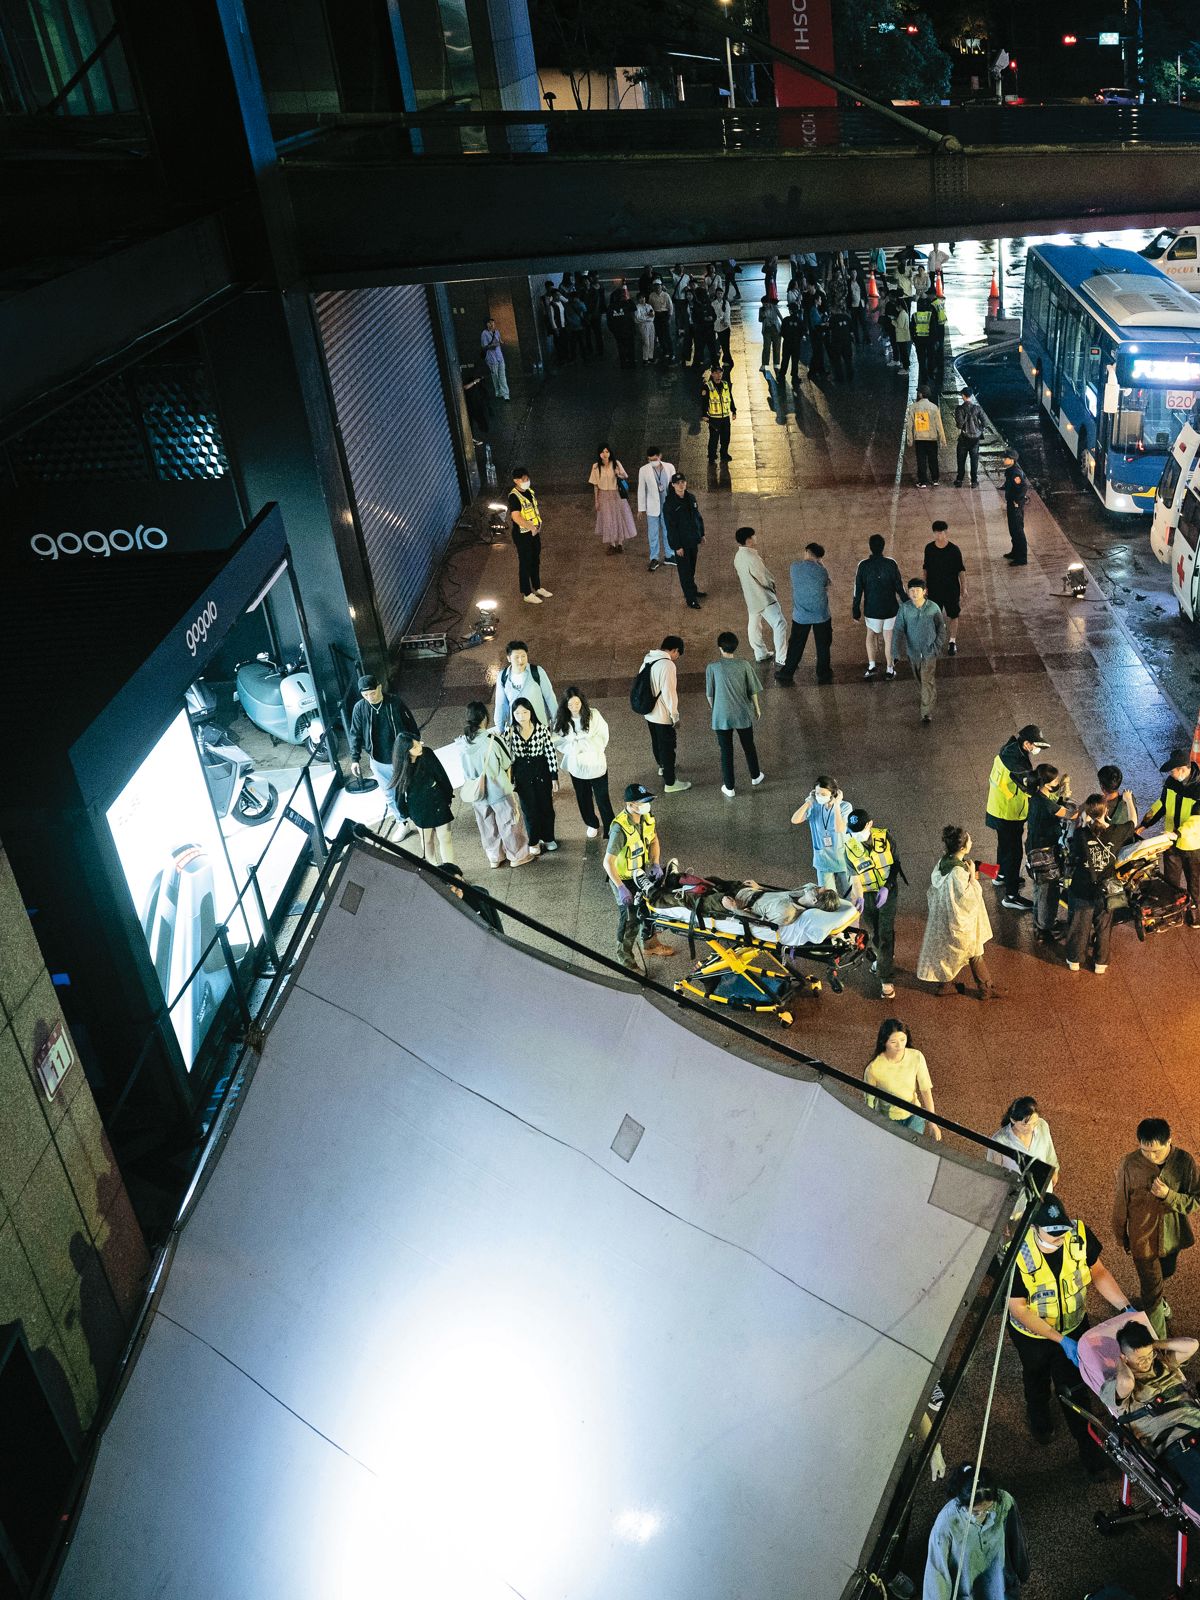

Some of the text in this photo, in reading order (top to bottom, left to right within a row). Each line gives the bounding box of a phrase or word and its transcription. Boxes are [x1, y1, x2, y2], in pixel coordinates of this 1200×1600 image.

[1166, 266, 1195, 275] FOCUS
[1167, 396, 1192, 408] 620
[30, 524, 168, 560] gogoro
[186, 601, 218, 656] gogoro
